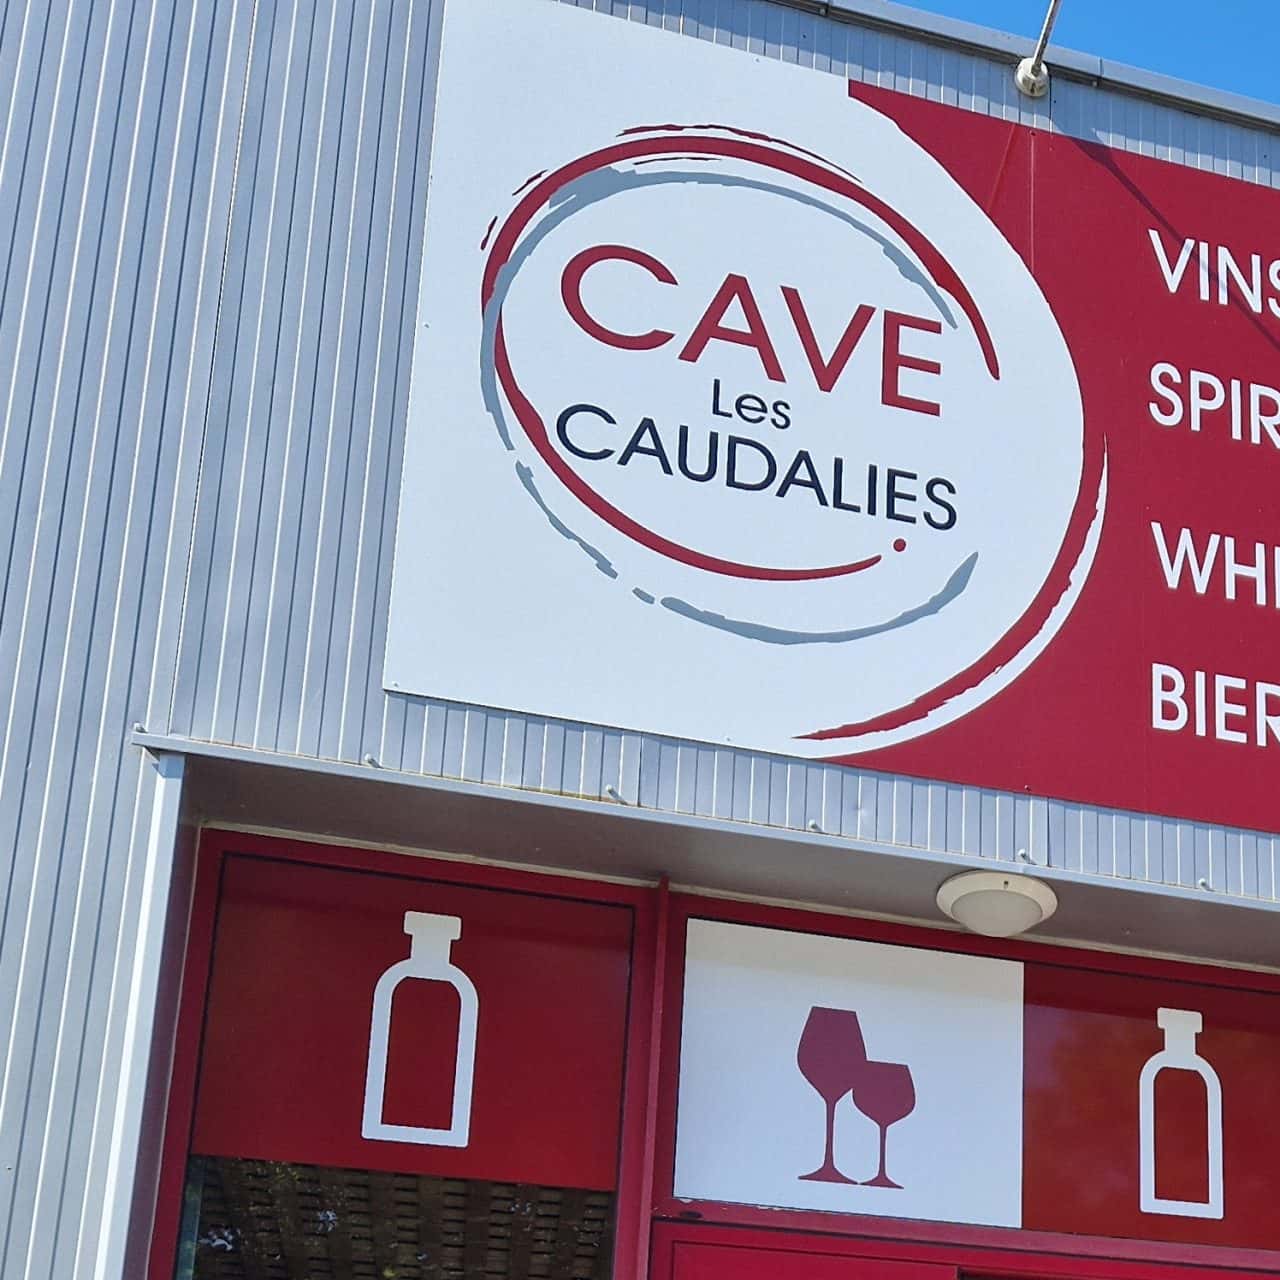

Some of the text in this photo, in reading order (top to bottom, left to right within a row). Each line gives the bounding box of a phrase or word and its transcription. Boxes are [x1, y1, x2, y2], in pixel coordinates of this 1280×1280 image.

[560, 244, 942, 417] CAVE
[555, 403, 958, 530] CAUDALIES
[711, 378, 791, 430] Les
